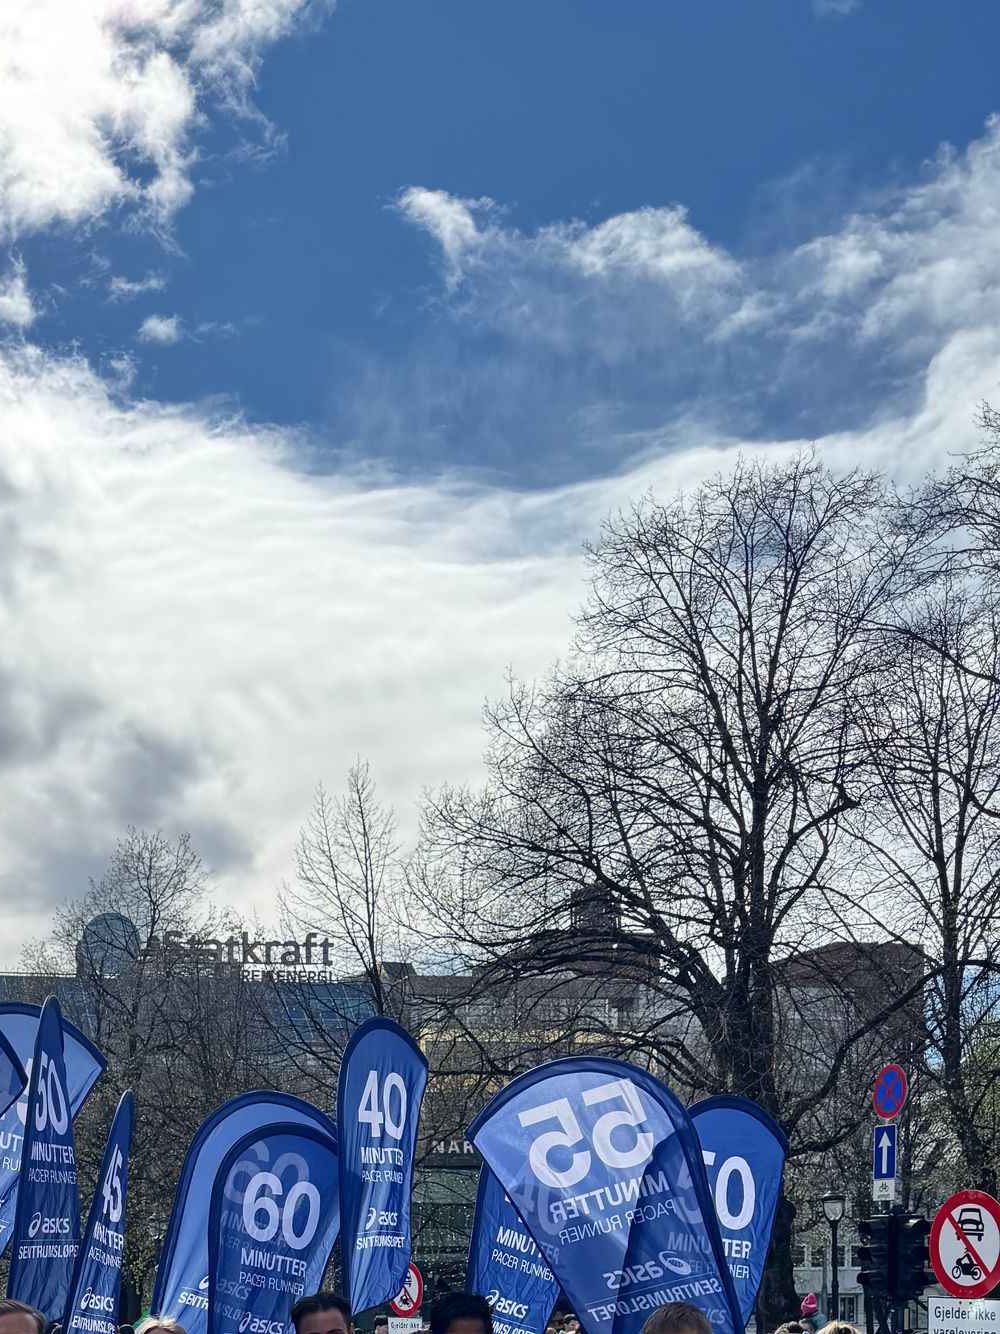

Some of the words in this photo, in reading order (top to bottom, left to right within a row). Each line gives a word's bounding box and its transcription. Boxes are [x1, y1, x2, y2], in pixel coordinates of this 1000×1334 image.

[163, 931, 335, 967] Statkraft
[35, 1050, 69, 1136] 50
[358, 1070, 407, 1140] 40
[30, 1140, 75, 1165] MINUTTER
[28, 1168, 50, 1182] PACER
[102, 1143, 123, 1223] 45
[243, 1171, 321, 1250] 60
[241, 1247, 308, 1278] MINUTTER
[492, 1248, 518, 1270] PACER
[239, 1271, 266, 1289] PACER
[268, 1277, 305, 1297] RUNNER
[934, 1305, 971, 1322] Gjelder
[975, 1308, 996, 1321] ikke
